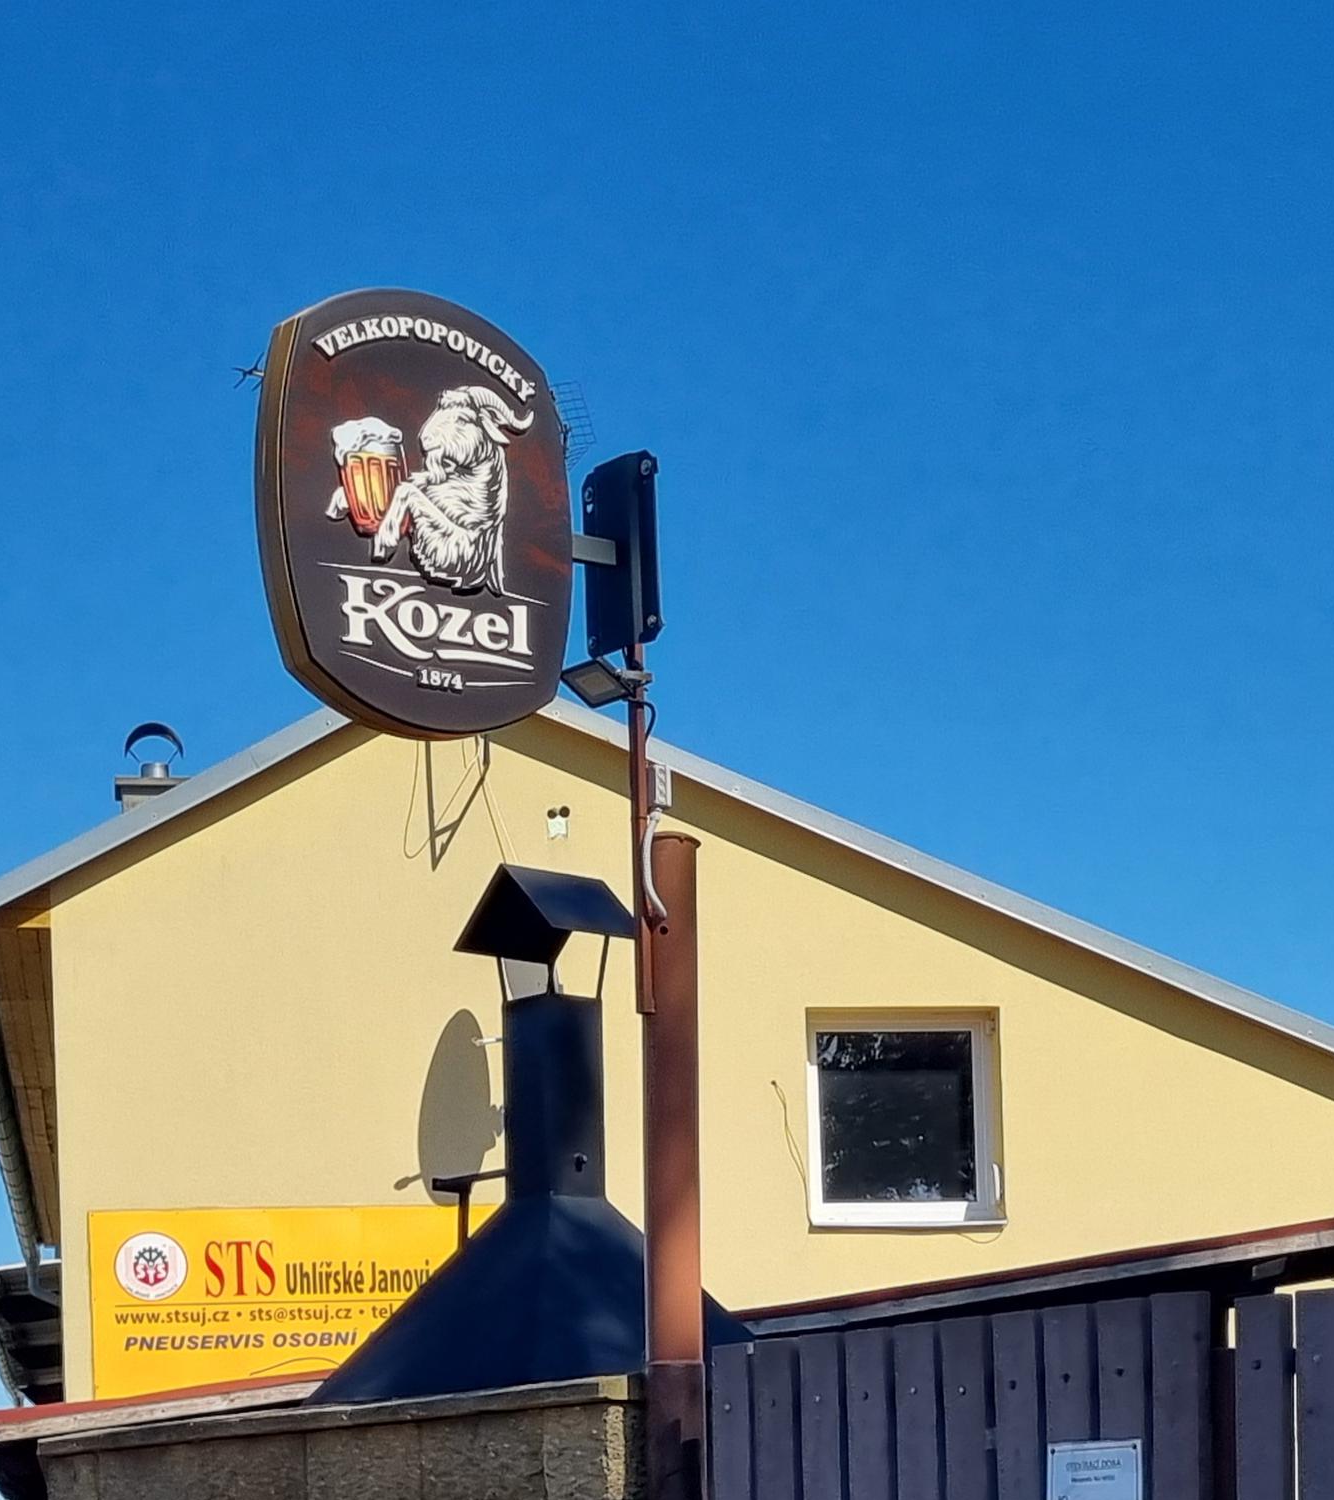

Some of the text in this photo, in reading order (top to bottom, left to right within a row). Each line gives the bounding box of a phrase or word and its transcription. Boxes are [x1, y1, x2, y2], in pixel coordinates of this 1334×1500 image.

[315, 315, 536, 402] VELKOPOPOVICKÝ
[339, 574, 534, 670] Kozel
[417, 667, 464, 692] 1874
[203, 1239, 433, 1298] STS Uhlířské Janovi
[114, 1307, 230, 1327] www.stsuj.cz
[248, 1304, 353, 1324] sts@stsuj.cz
[124, 1328, 358, 1352] PNEUSERVIS OSOBNÍ
